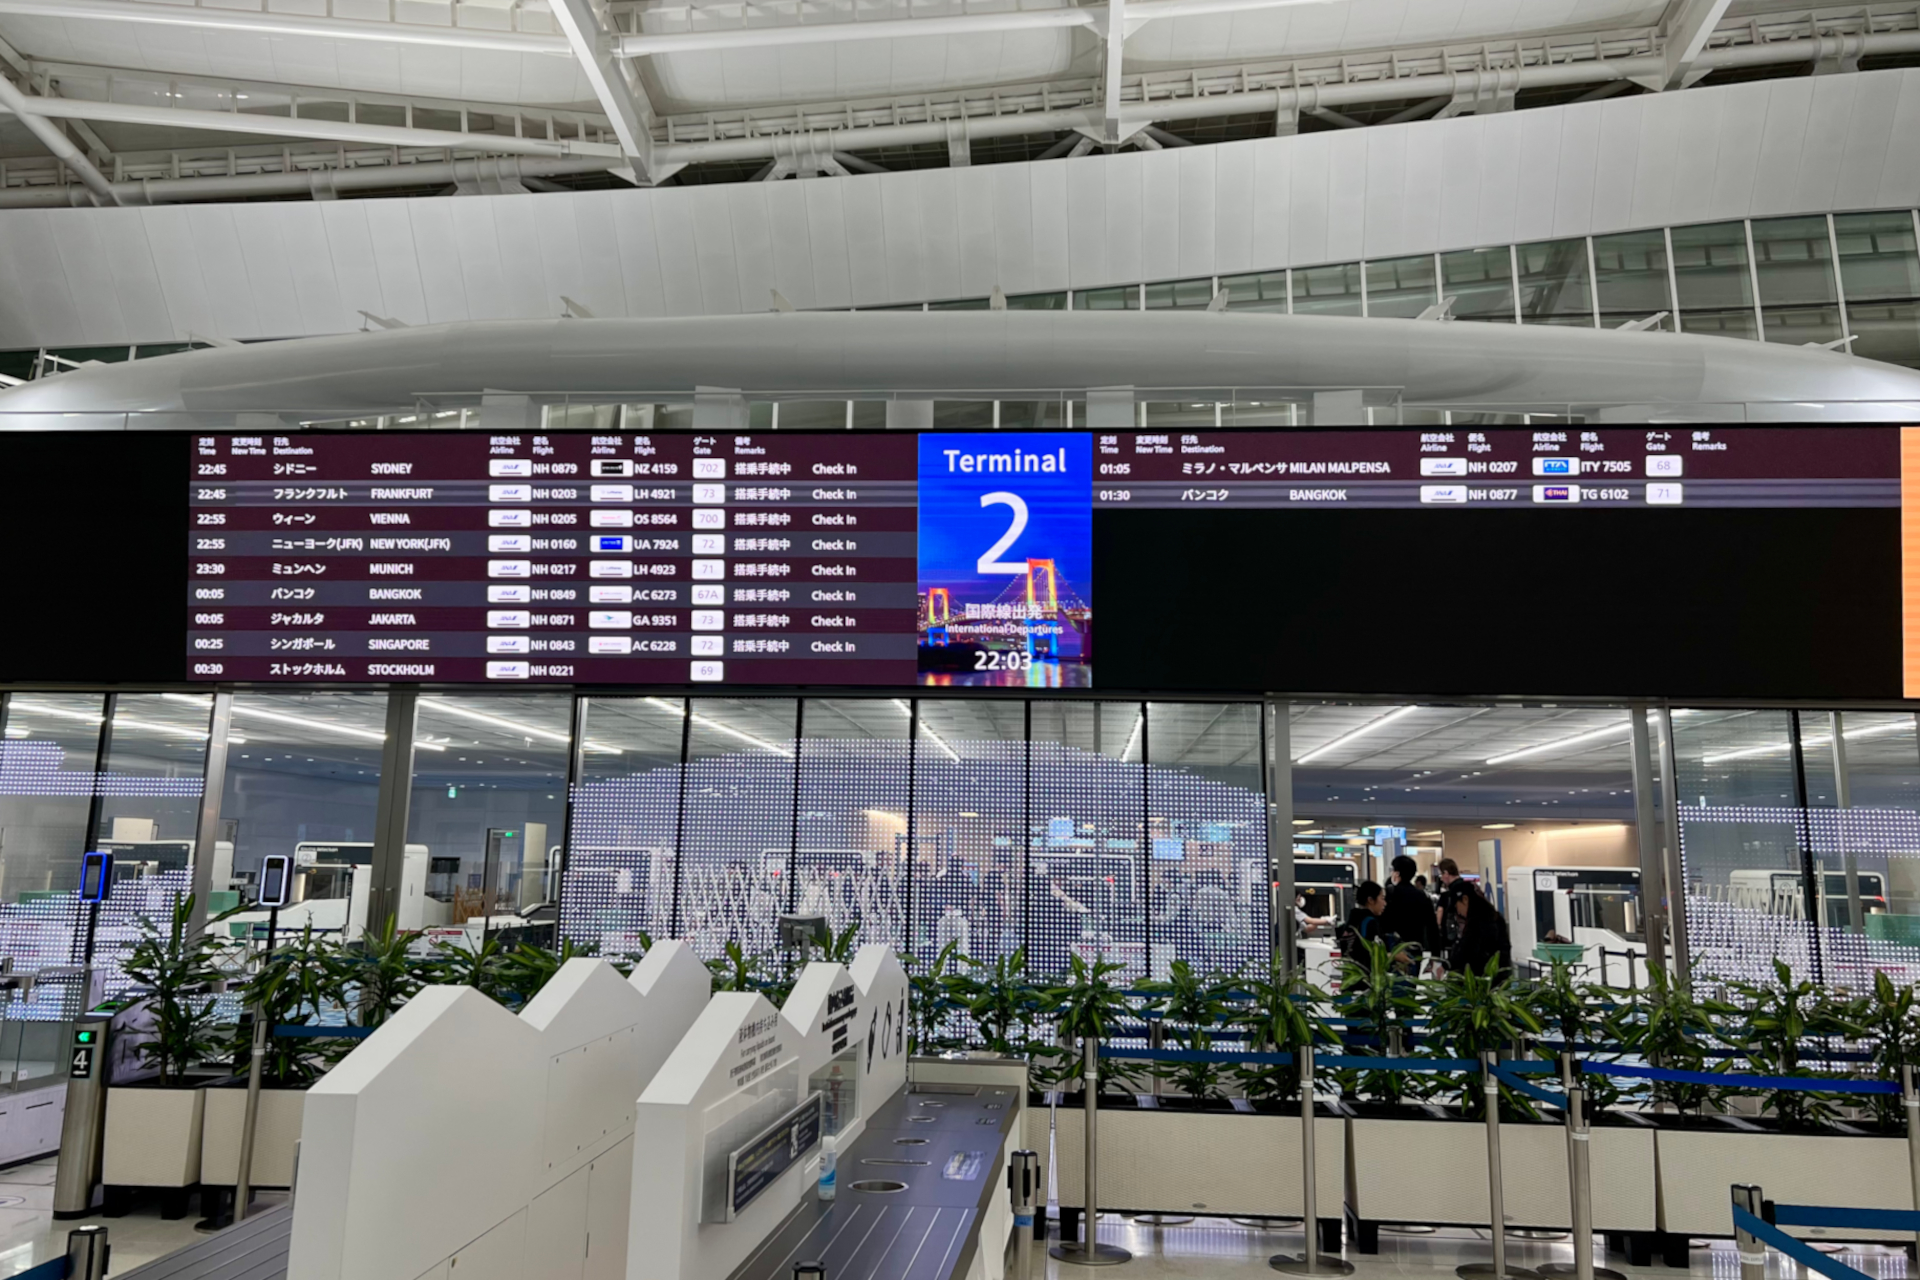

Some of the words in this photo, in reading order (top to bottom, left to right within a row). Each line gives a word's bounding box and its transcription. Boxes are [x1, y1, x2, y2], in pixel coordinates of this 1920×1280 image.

[693, 436, 717, 446] ゲート
[1645, 432, 1672, 441] ゲート
[198, 447, 217, 456] Time
[231, 447, 248, 456] New
[248, 447, 267, 456] Time
[272, 446, 314, 456] Destination
[489, 446, 515, 455] Airline
[532, 446, 554, 456] Flight
[590, 446, 617, 455] Airline
[634, 446, 656, 456] Flight
[693, 446, 712, 455] Gate
[734, 446, 766, 455] Remarks
[1100, 445, 1119, 454] Time
[1135, 445, 1154, 454] New
[1154, 445, 1174, 454] Time
[1180, 445, 1225, 454] Destination
[1420, 443, 1448, 452] Airline
[1468, 443, 1492, 453] Flight
[1532, 443, 1560, 452] Airline
[1580, 443, 1604, 453] Flight
[1645, 442, 1667, 452] Gate
[1691, 441, 1728, 451] Remarks
[943, 447, 1067, 473] Terminal
[1656, 460, 1672, 471] 68
[197, 463, 227, 475] 22:45
[273, 463, 317, 475] シドニー
[370, 462, 413, 475] SYDNEY
[532, 463, 550, 474] NH
[551, 463, 578, 474] 0879
[634, 463, 651, 475] NZ
[651, 463, 678, 474] 4159
[699, 462, 719, 473] 702
[734, 462, 792, 475] 搭乗手続中
[812, 463, 845, 475] Check
[846, 463, 857, 474] In
[1099, 463, 1131, 475] 01:05
[1182, 461, 1288, 475] ミラノ・マルペンサ
[1289, 462, 1326, 474] MILAN
[1327, 461, 1391, 474] MALPENSA
[1468, 461, 1487, 473] NH
[1488, 461, 1518, 473] 0207
[1580, 460, 1601, 473] ITY
[1602, 460, 1632, 473] 7505
[197, 488, 227, 500] 22:45
[273, 487, 349, 500] フランクフルト
[370, 487, 434, 500] FRANKFURT
[532, 488, 550, 499] NH
[550, 488, 578, 500] 0203
[634, 488, 650, 500] LH
[649, 488, 676, 500] 4921
[702, 488, 716, 499] 73
[734, 487, 792, 501] 搭乗手続中
[811, 488, 845, 500] Check
[846, 489, 857, 500] In
[1099, 489, 1131, 501] 01:30
[1289, 488, 1348, 501] BANGKOK
[1468, 488, 1487, 500] NH
[1488, 488, 1518, 501] 0877
[1580, 488, 1598, 500] TG
[1599, 488, 1630, 500] 6102
[1657, 488, 1670, 499] 71
[197, 513, 226, 525] 22:55
[272, 512, 316, 525] ウィーン
[369, 513, 411, 525] VIENNA
[532, 513, 550, 524] NH
[550, 513, 578, 525] 0205
[634, 513, 650, 525] OS
[650, 513, 678, 525] 8564
[699, 513, 719, 524] 700
[734, 512, 791, 526] 搭乗手続中
[811, 513, 845, 525] Check
[846, 514, 857, 525] In
[976, 491, 1029, 574] 2
[196, 538, 226, 550] 22:55
[271, 537, 364, 552] ニューヨーク(JFK)
[369, 538, 395, 550] NEW
[395, 537, 451, 552] YORK(JFK)
[531, 538, 549, 550] NH
[550, 538, 578, 550] 0160
[633, 539, 652, 550] UA
[652, 539, 680, 550] 7924
[702, 538, 715, 550] 72
[733, 537, 791, 551] 搭乗手続中
[811, 539, 844, 551] Check
[845, 539, 857, 551] In
[196, 563, 226, 575] 23:30
[272, 563, 326, 575] ミュンヘン
[369, 563, 414, 575] MUNICH
[531, 564, 549, 575] NH
[550, 564, 577, 575] 0217
[633, 564, 649, 575] LH
[649, 564, 676, 575] 4923
[701, 564, 714, 575] 71
[733, 563, 791, 577] 搭乗手続中
[811, 564, 844, 576] Check
[845, 565, 856, 576] In
[195, 588, 225, 600] 00:05
[369, 588, 422, 600] BANGKOK
[531, 589, 549, 600] NH
[549, 589, 577, 600] 0849
[632, 589, 650, 601] AC
[650, 589, 677, 601] 6273
[697, 589, 719, 601] 67A
[733, 588, 791, 602] 搭乗手続中
[811, 589, 844, 602] Check
[845, 590, 856, 601] In
[964, 602, 1044, 621] 国際線出発
[194, 613, 224, 625] 00:05
[270, 612, 325, 626] ジャカルタ
[368, 613, 416, 625] JAKARTA
[530, 614, 548, 626] NH
[549, 614, 575, 626] 0871
[632, 614, 651, 626] GA
[651, 615, 677, 626] 9351
[701, 614, 714, 626] 73
[733, 614, 790, 627] 搭乗手続中
[810, 615, 844, 627] Check
[845, 616, 856, 627] In
[944, 623, 1008, 635] International
[1008, 624, 1064, 635] Departures
[194, 638, 224, 650] 00:25
[270, 637, 336, 650] シンガポール
[368, 638, 430, 651] SINGAPORE
[530, 639, 548, 651] NH
[548, 639, 576, 651] 0843
[632, 640, 649, 652] AC
[649, 640, 677, 652] 6228
[701, 640, 714, 651] 72
[732, 639, 790, 653] 搭乗手続中
[810, 640, 844, 653] Check
[844, 641, 856, 652] In
[973, 650, 1034, 671] 22:03
[194, 663, 224, 675] 00:30
[270, 662, 346, 676] ストックホルム
[367, 663, 435, 676] STOCKHOLM
[529, 665, 548, 676] NH
[548, 665, 574, 677] 0221
[700, 665, 714, 676] 69
[73, 1050, 88, 1069] 4
